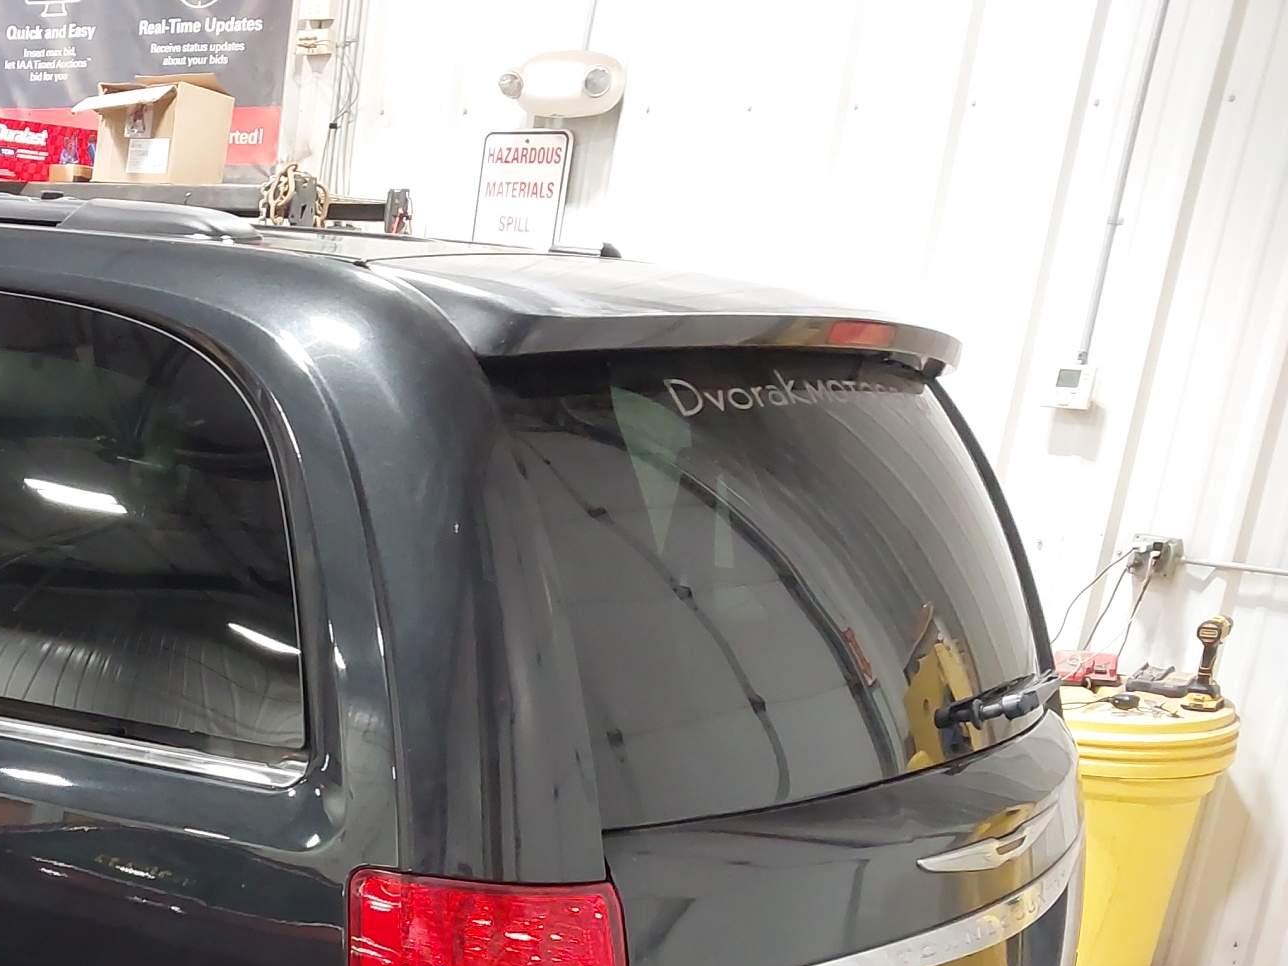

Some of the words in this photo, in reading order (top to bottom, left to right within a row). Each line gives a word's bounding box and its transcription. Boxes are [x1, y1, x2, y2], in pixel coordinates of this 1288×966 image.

[6, 25, 43, 41] Quick
[44, 24, 67, 39] and
[68, 23, 97, 41] Easy
[138, 18, 202, 36] Real-Time
[204, 17, 263, 36] Updates
[150, 43, 181, 54] Receive
[182, 42, 208, 52] status
[209, 41, 245, 54] updates
[162, 55, 187, 66] about
[187, 56, 208, 67] your
[209, 54, 229, 65] bids
[487, 147, 563, 165] HAZARDOUS
[485, 181, 555, 199] MATERIALS
[498, 215, 530, 233] SPILL
[663, 369, 812, 417] Dvorak
